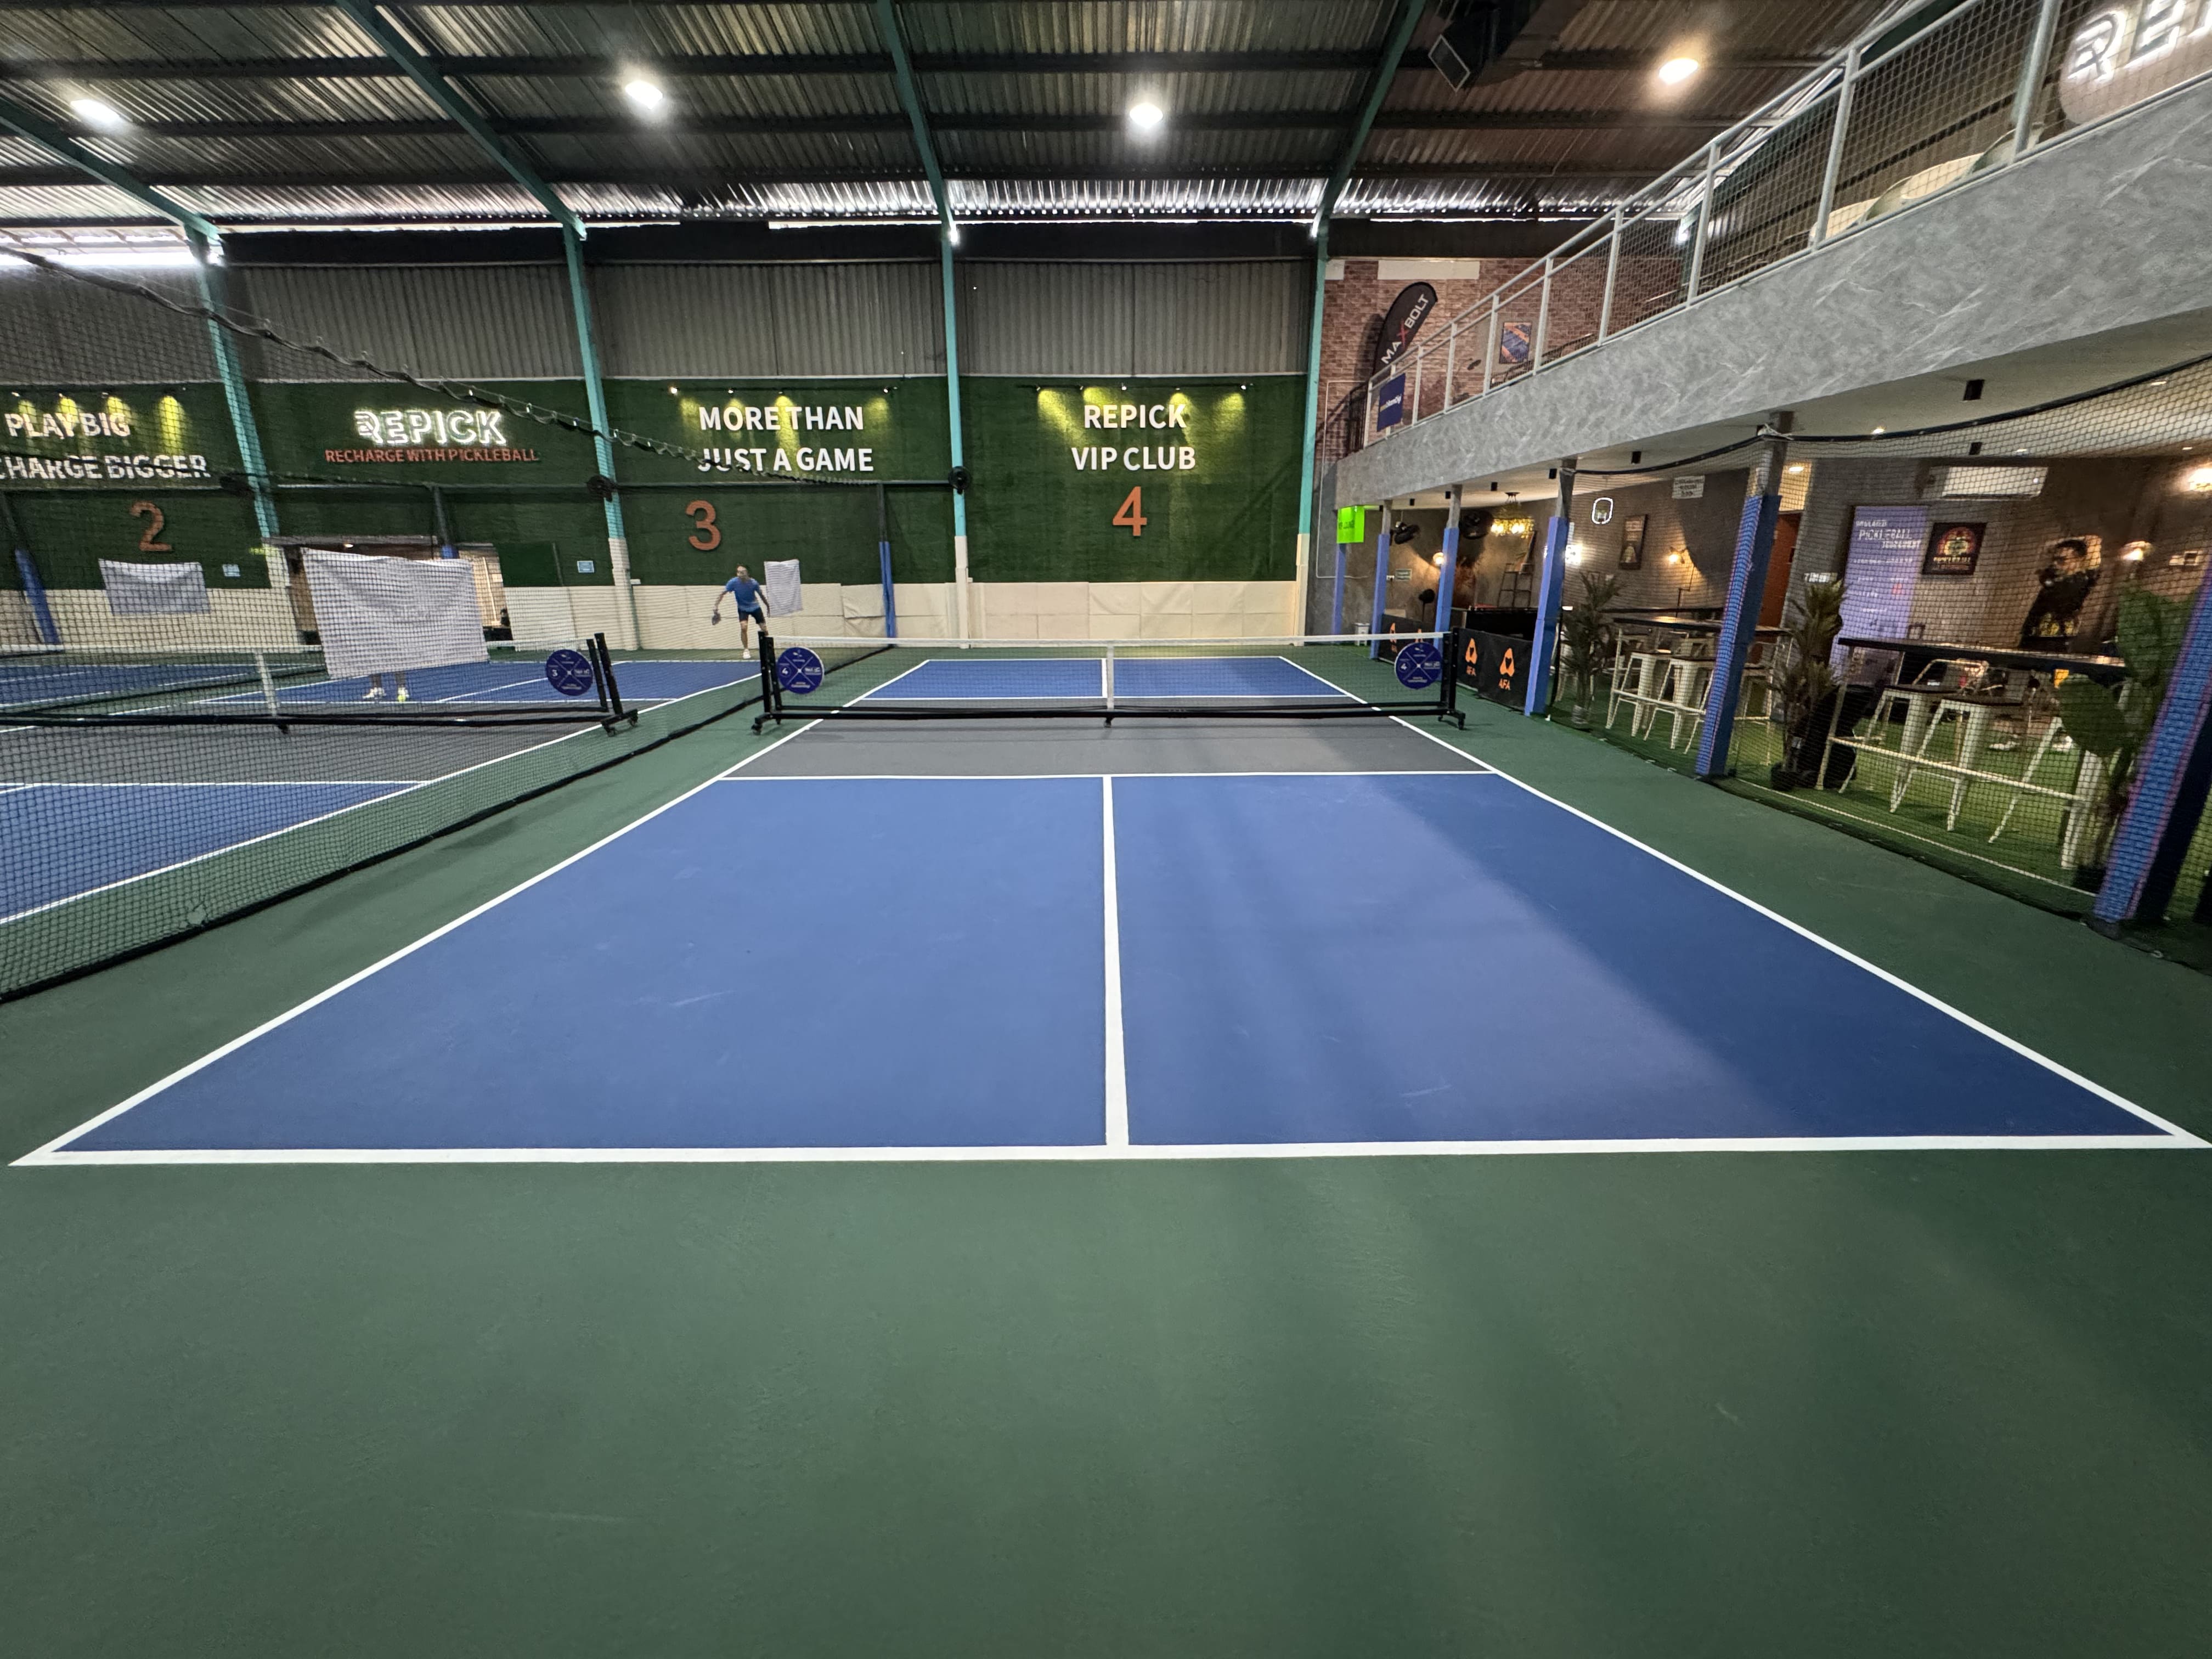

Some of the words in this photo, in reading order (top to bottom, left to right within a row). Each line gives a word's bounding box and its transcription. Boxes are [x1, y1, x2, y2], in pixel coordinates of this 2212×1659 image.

[2067, 0, 2212, 84] RE
[4, 413, 75, 439] PLAY
[79, 413, 131, 437] BIG
[354, 410, 507, 445] REPICK
[698, 407, 781, 431] MORE
[785, 407, 864, 431] THAN
[1084, 404, 1187, 429] REPICK
[104, 454, 211, 479] BIGGER
[325, 449, 404, 462] RECHARGE
[406, 449, 445, 462] WITH
[448, 448, 539, 461] PICKLEBALL
[697, 447, 767, 472] JUST
[773, 448, 792, 472] A
[796, 447, 874, 472] GAME
[1071, 447, 1118, 471] VIP
[1123, 446, 1195, 471] CLUB
[1112, 486, 1148, 537] 4
[129, 501, 172, 552] 2
[685, 500, 721, 551] 3
[1498, 678, 1511, 690] AFA
